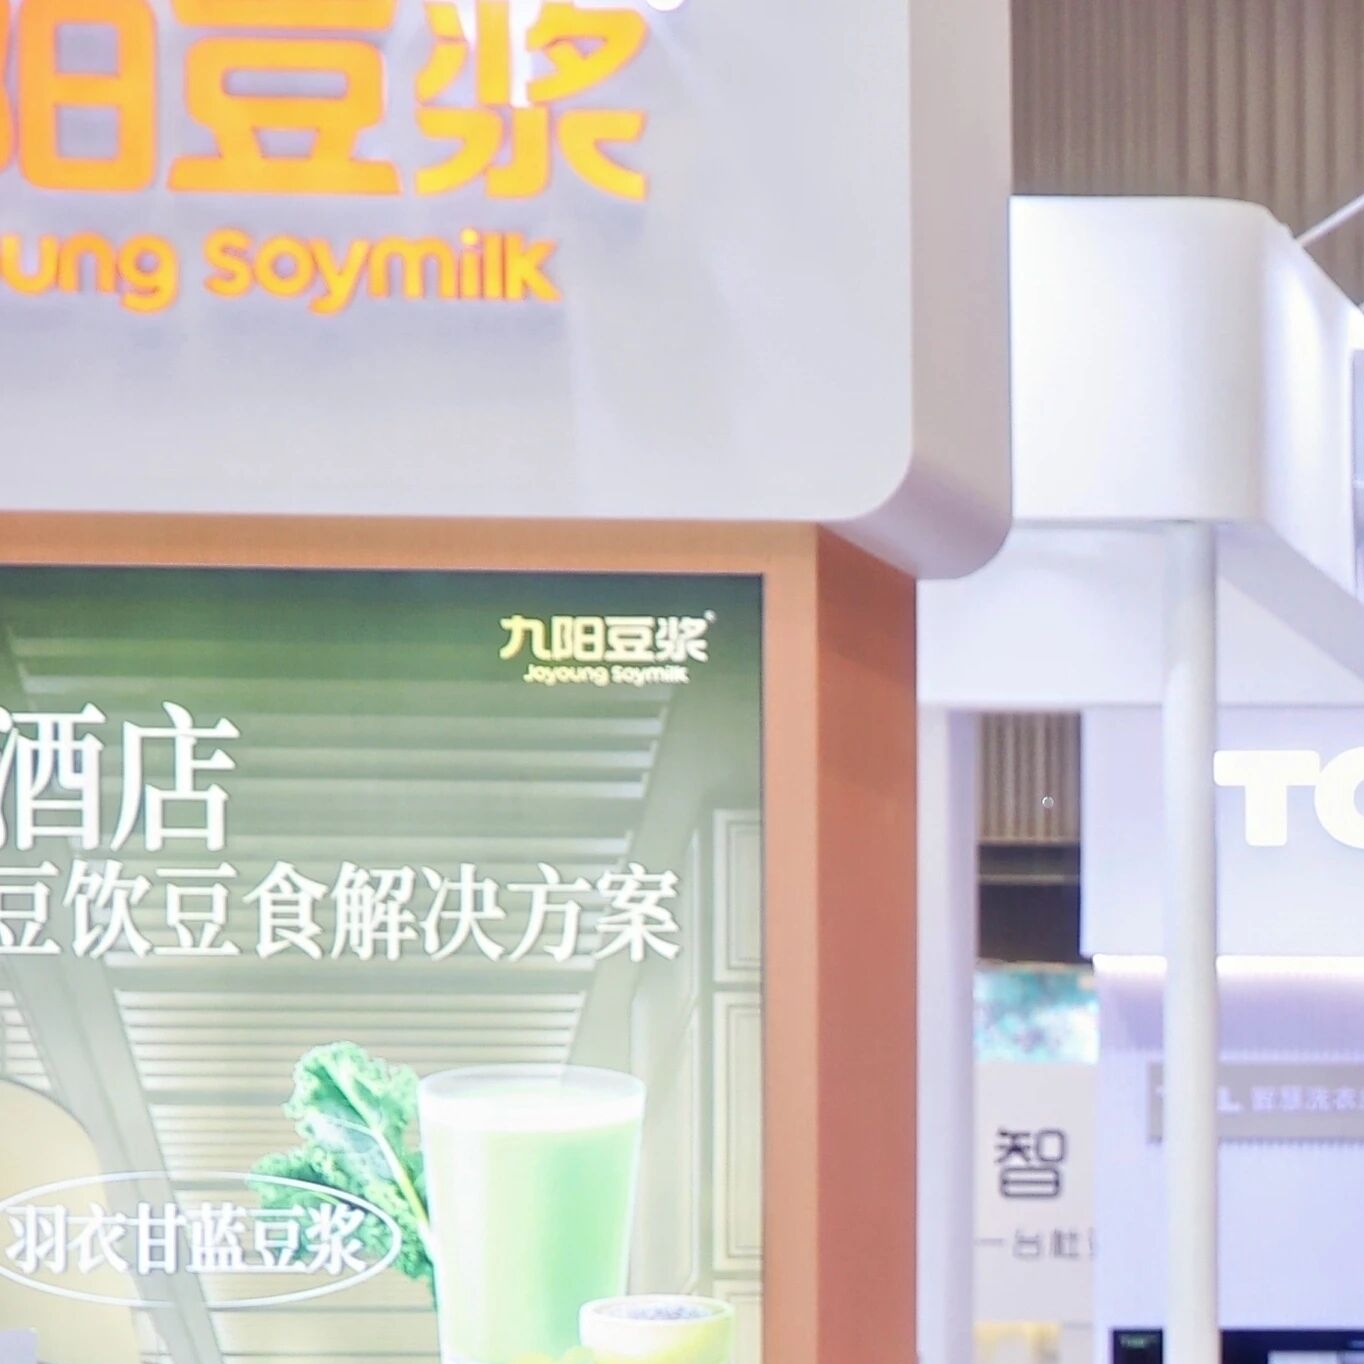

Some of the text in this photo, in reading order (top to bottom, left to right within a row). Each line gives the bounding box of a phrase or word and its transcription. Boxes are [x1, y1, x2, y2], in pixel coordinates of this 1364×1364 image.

[203, 227, 562, 316] Soymilk
[499, 614, 709, 662] 九阳豆浆
[993, 1128, 1067, 1198] 智
[4, 1202, 368, 1276] 羽衣甘蓝豆浆
